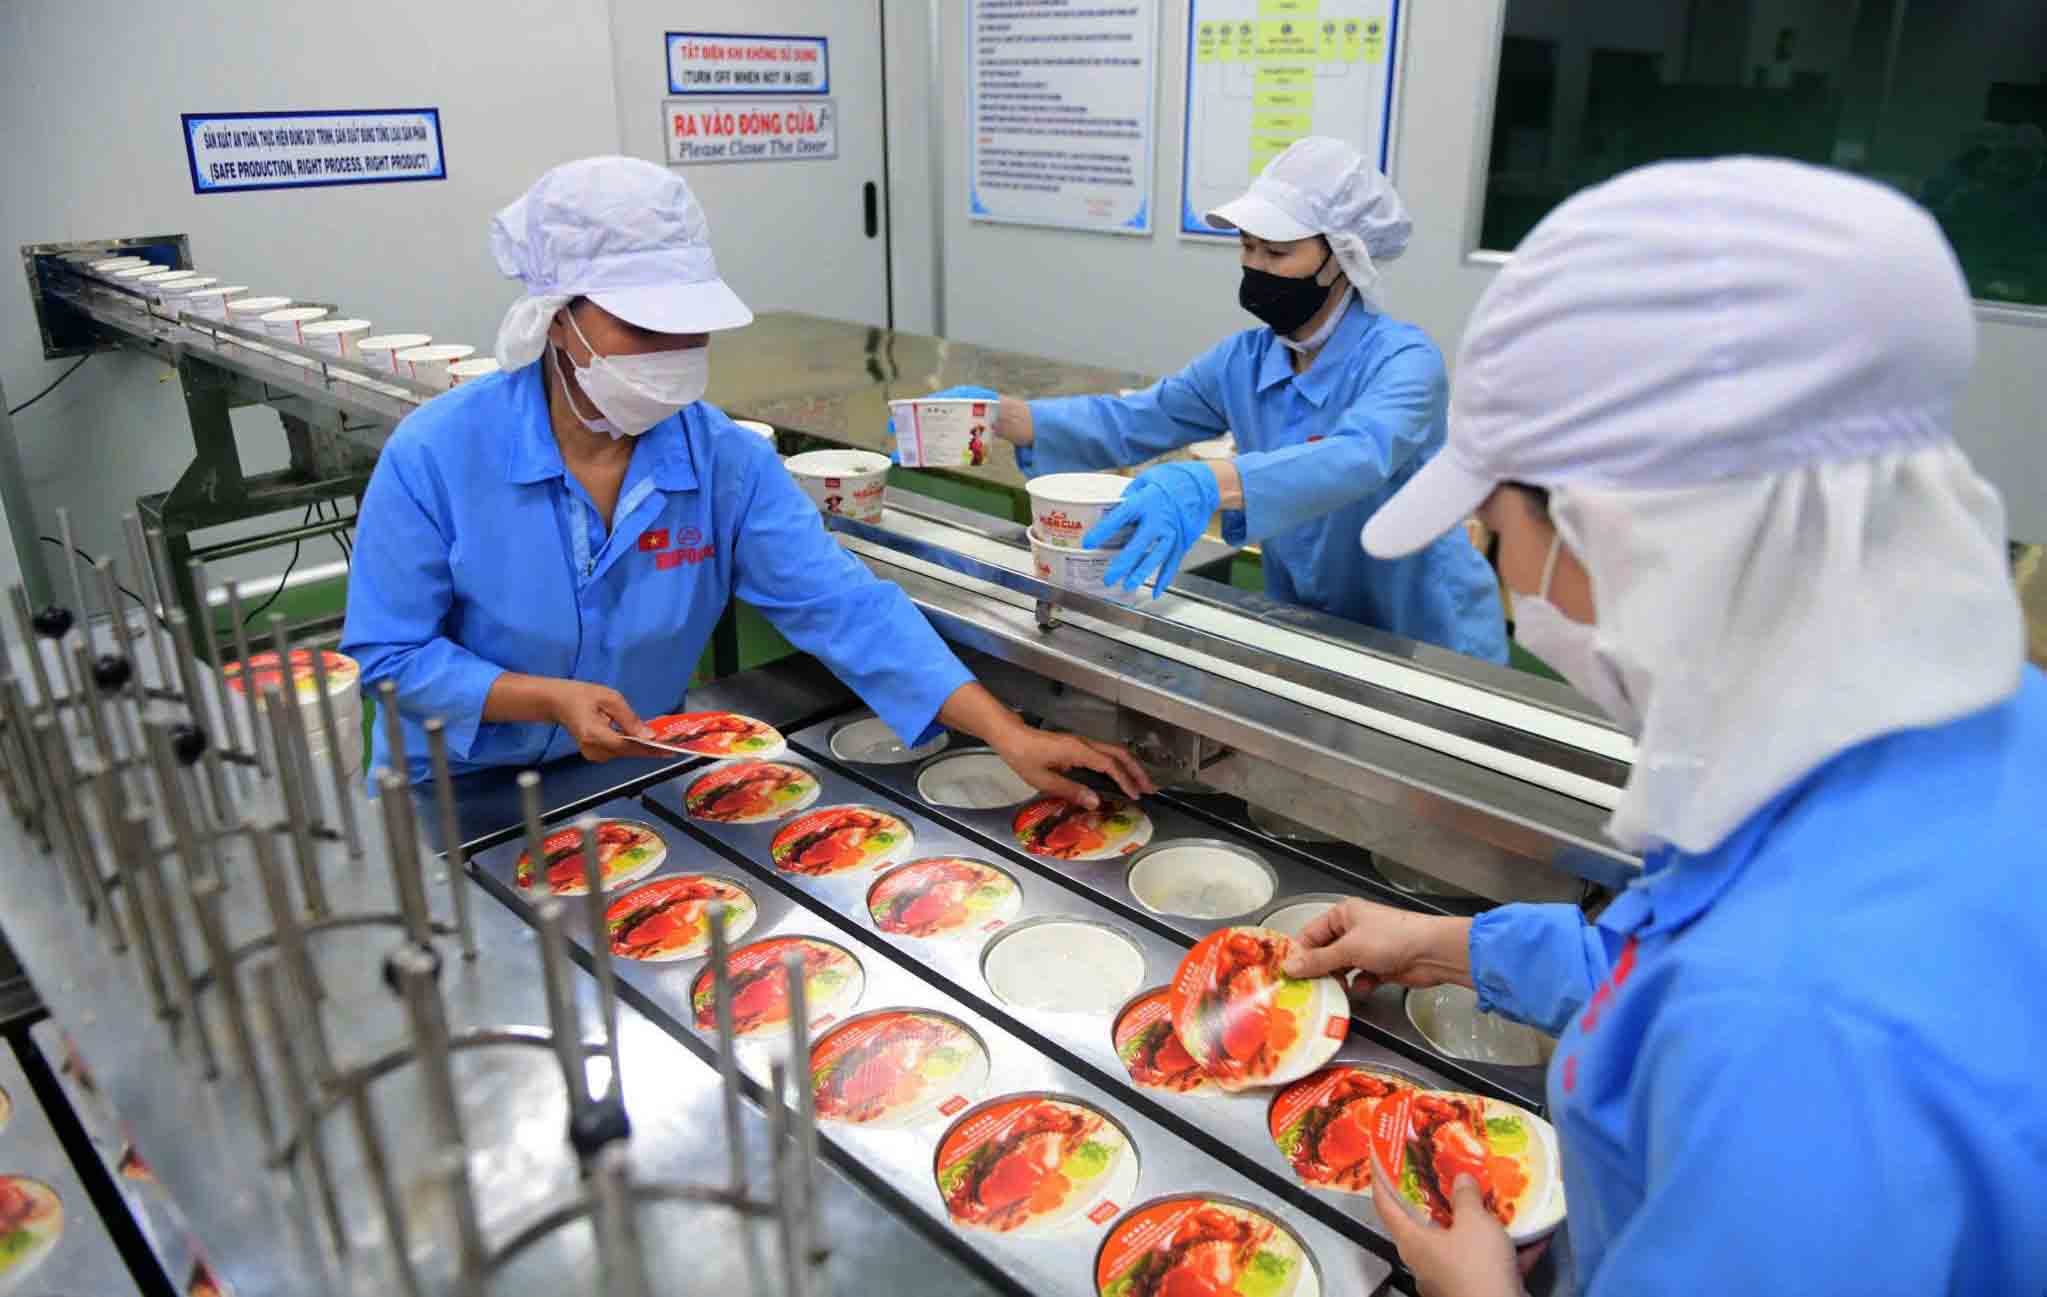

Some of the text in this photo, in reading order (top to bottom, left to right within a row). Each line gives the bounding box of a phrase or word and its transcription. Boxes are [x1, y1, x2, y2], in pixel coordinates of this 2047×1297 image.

[714, 70, 731, 83] OFF
[733, 69, 760, 84] WHEN
[763, 70, 781, 83] NOT
[784, 71, 791, 82] IN
[674, 113, 697, 136] RA
[680, 138, 827, 158] Please Close The Door
[210, 153, 431, 184] (SAFE PRODUCTION, RIGHT PROCESS, RIGHT PRODUCT)
